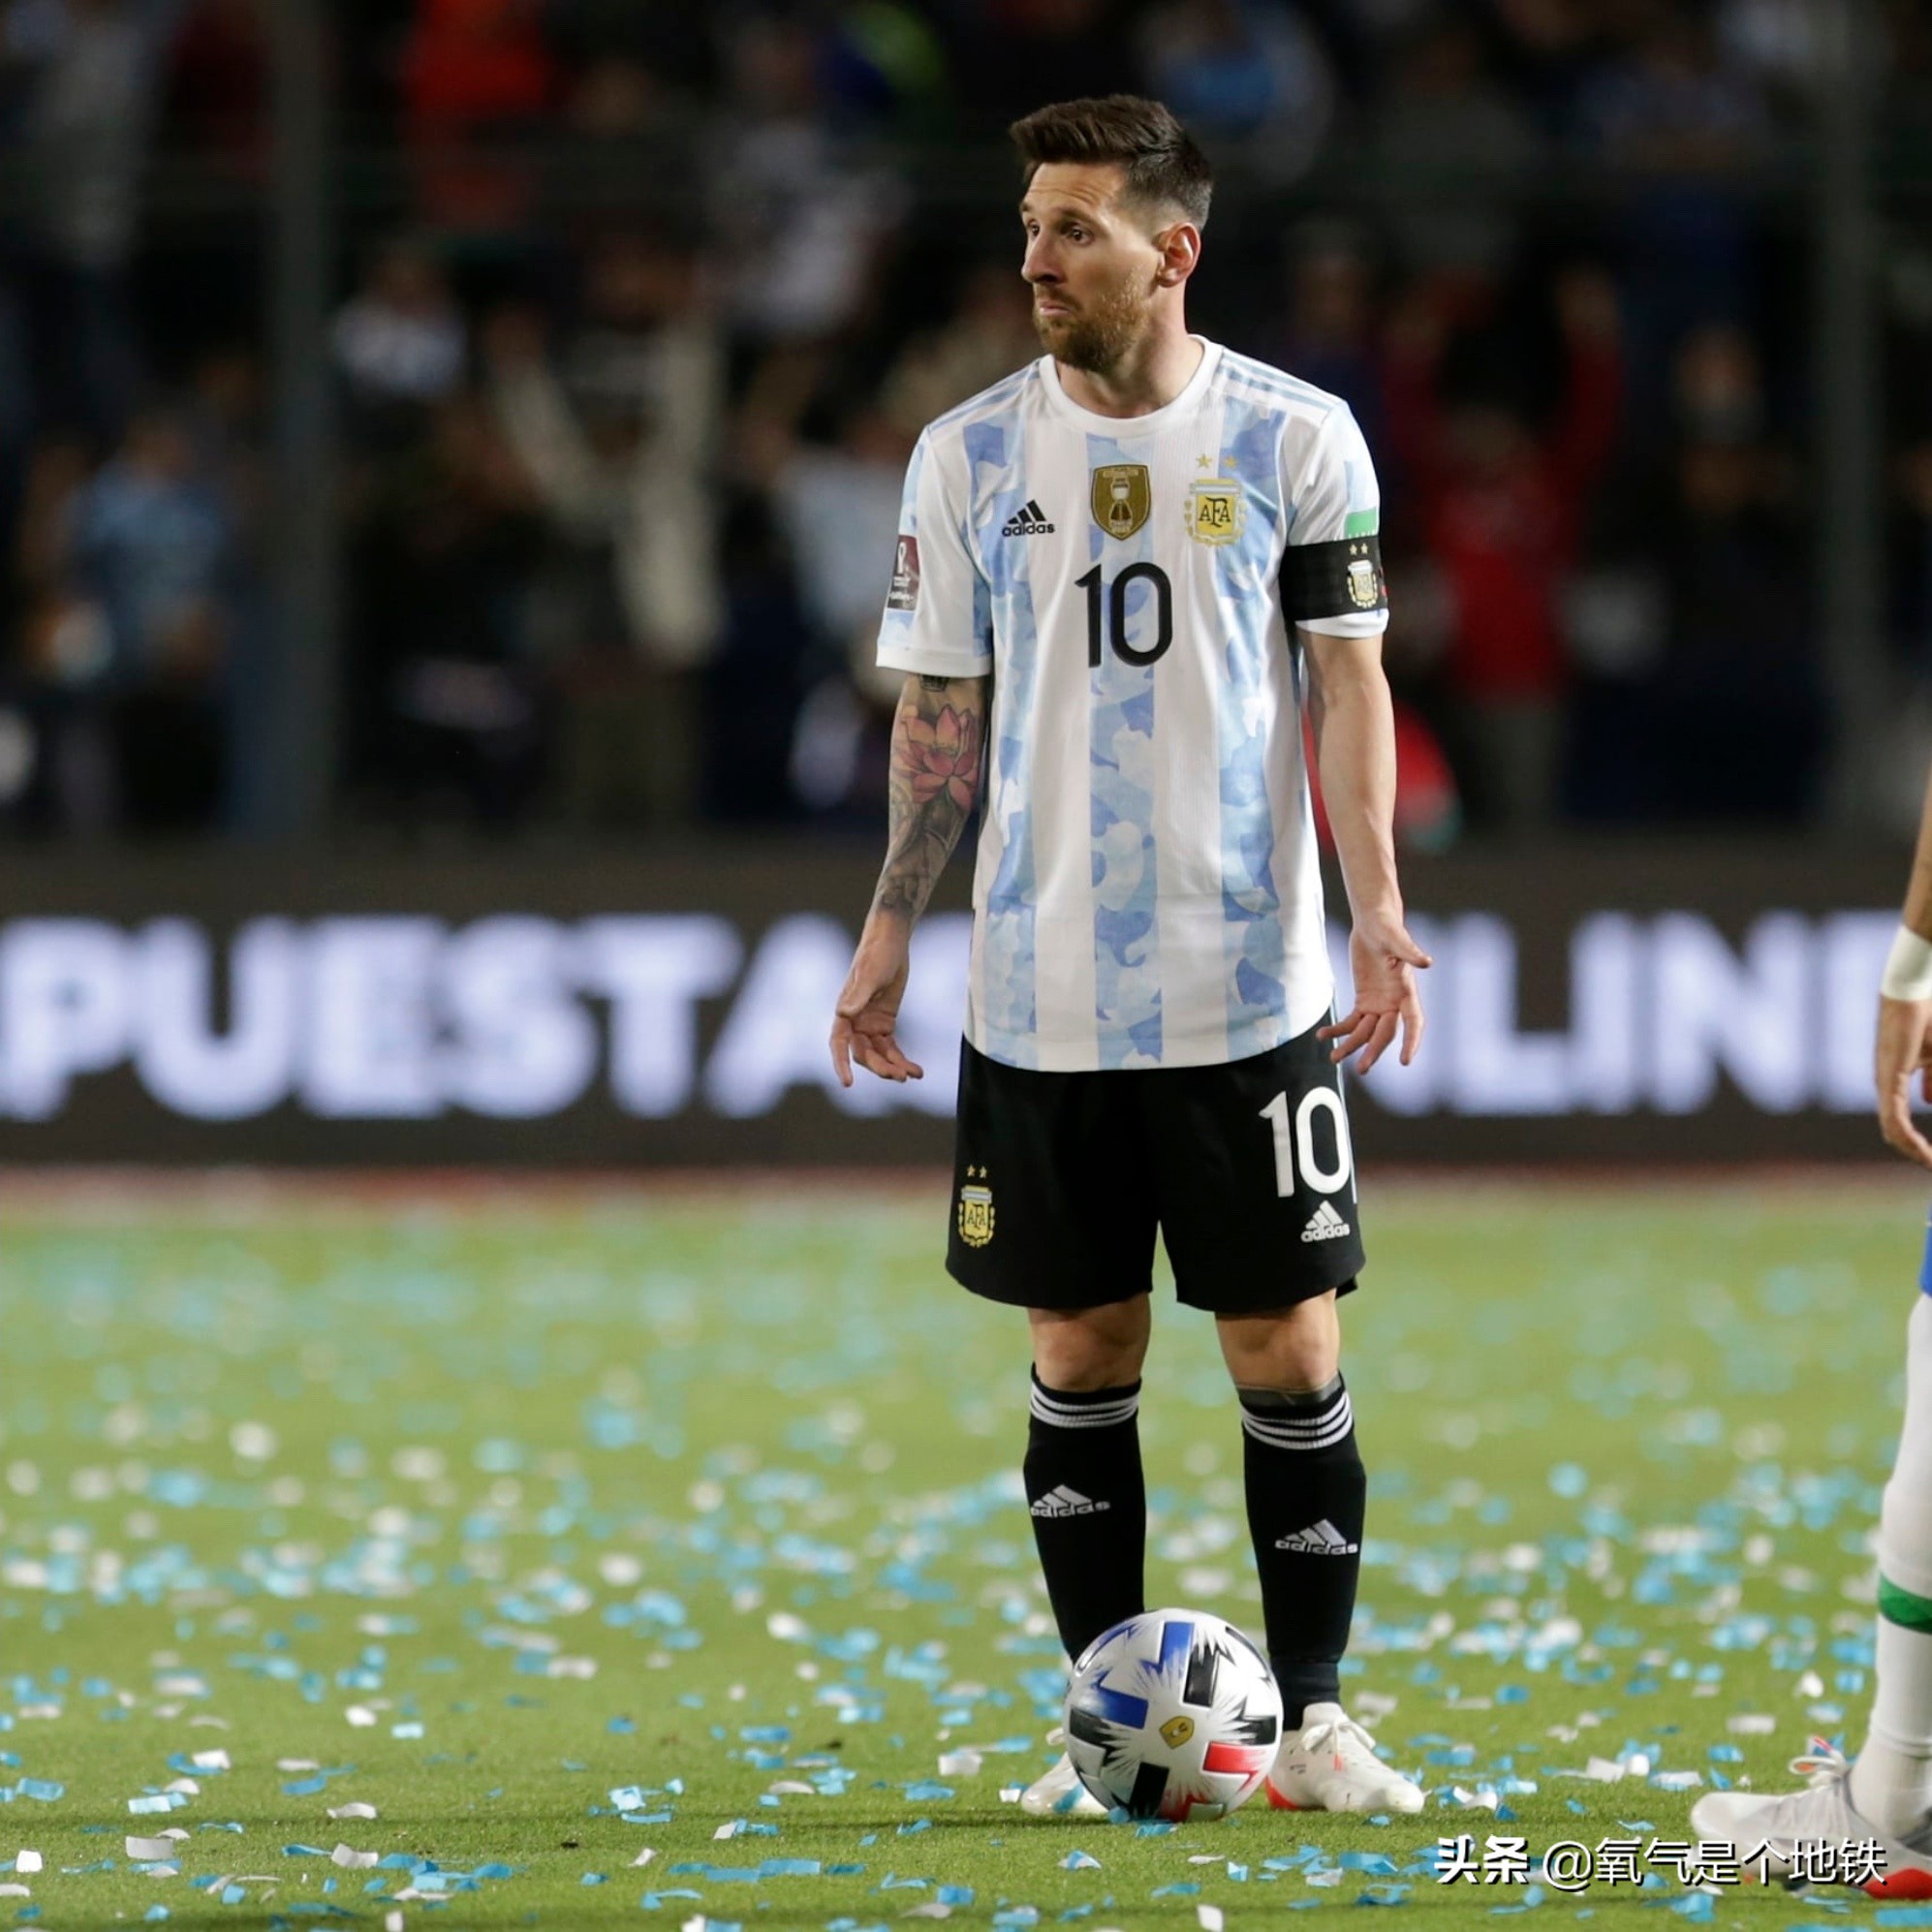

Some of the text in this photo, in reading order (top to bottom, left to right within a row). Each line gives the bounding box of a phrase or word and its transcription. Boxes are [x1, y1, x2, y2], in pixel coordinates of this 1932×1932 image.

[1199, 496, 1231, 528] AFA
[1002, 522, 1055, 537] adidas
[1074, 561, 1173, 669] 10
[1258, 1085, 1352, 1198] 10
[1300, 1222, 1351, 1243] adidas
[1030, 1501, 1110, 1518] adidas
[1275, 1539, 1358, 1556] adidas
